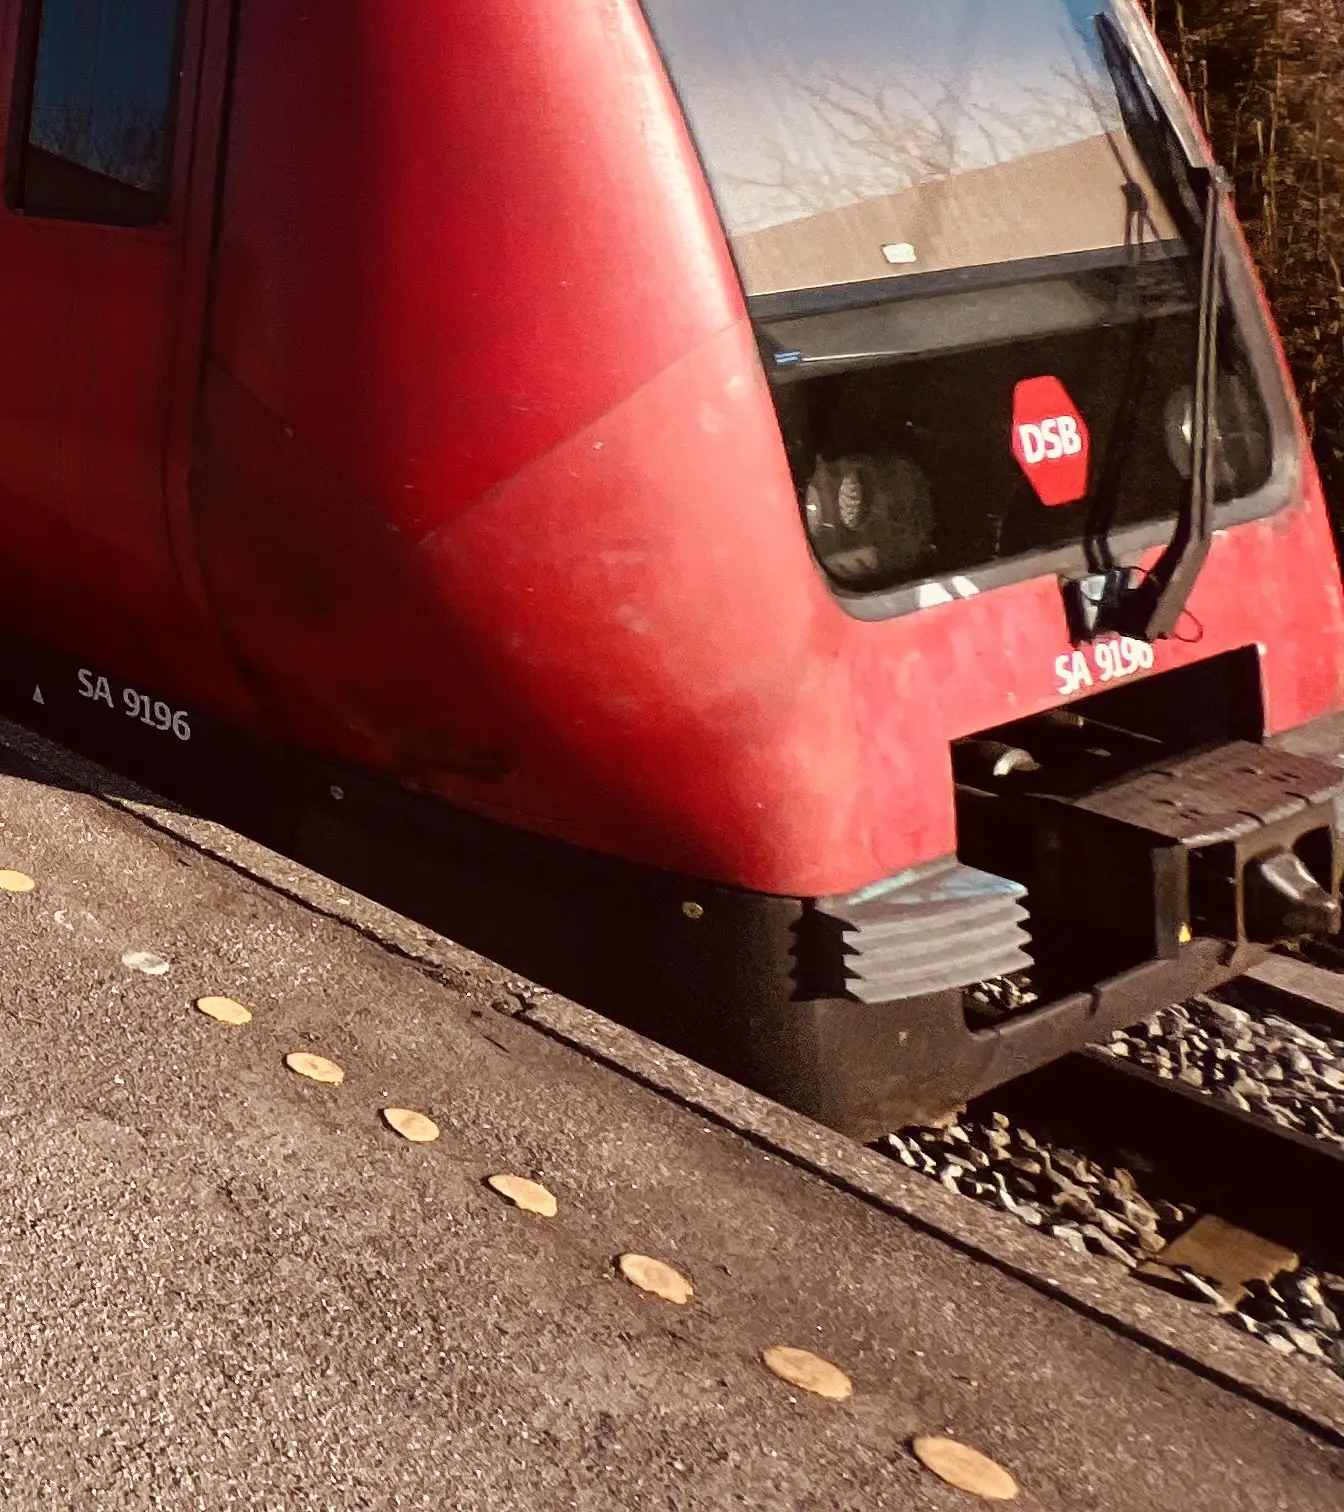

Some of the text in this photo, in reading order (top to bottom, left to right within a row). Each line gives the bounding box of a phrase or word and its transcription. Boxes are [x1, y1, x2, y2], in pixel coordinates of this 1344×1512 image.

[1018, 414, 1083, 464] DSB
[1055, 650, 1093, 695] SA
[77, 668, 192, 742] SA 9196
